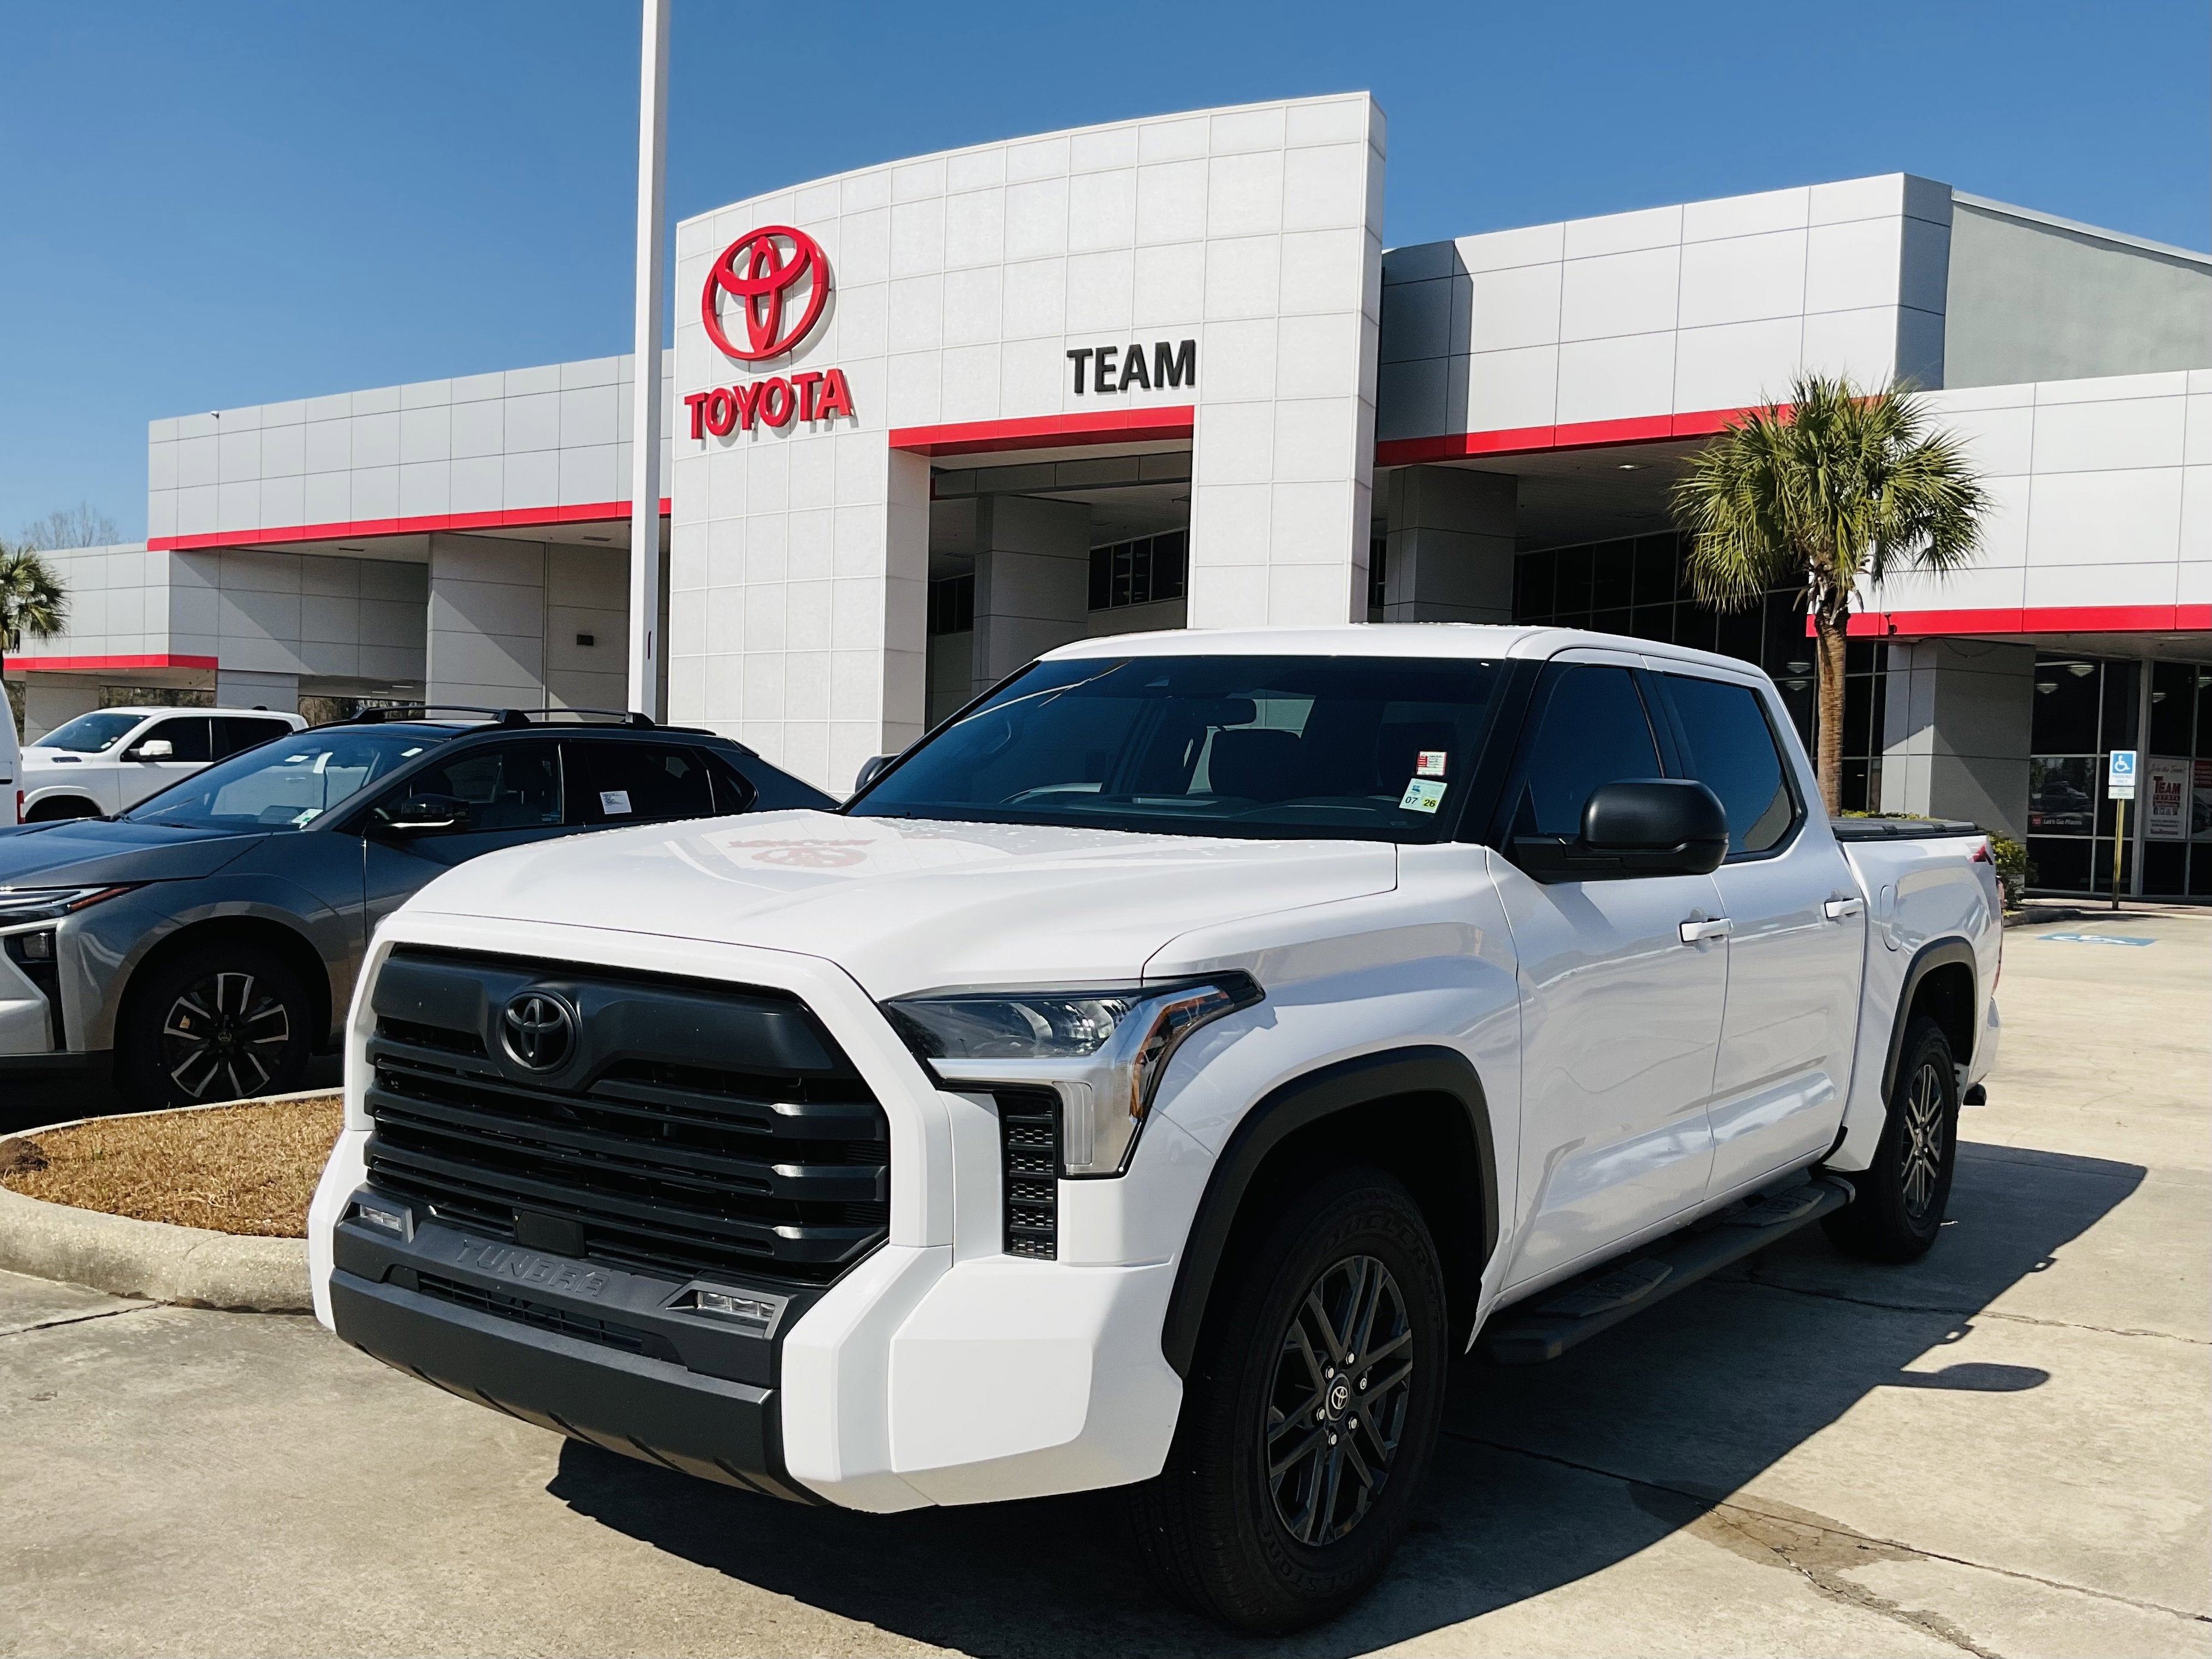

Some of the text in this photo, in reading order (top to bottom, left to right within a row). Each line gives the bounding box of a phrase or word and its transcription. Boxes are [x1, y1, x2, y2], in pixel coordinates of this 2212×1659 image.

[1067, 339, 1195, 394] TEAM
[684, 368, 852, 439] TOYOTA
[456, 1239, 612, 1297] TUNDRA
